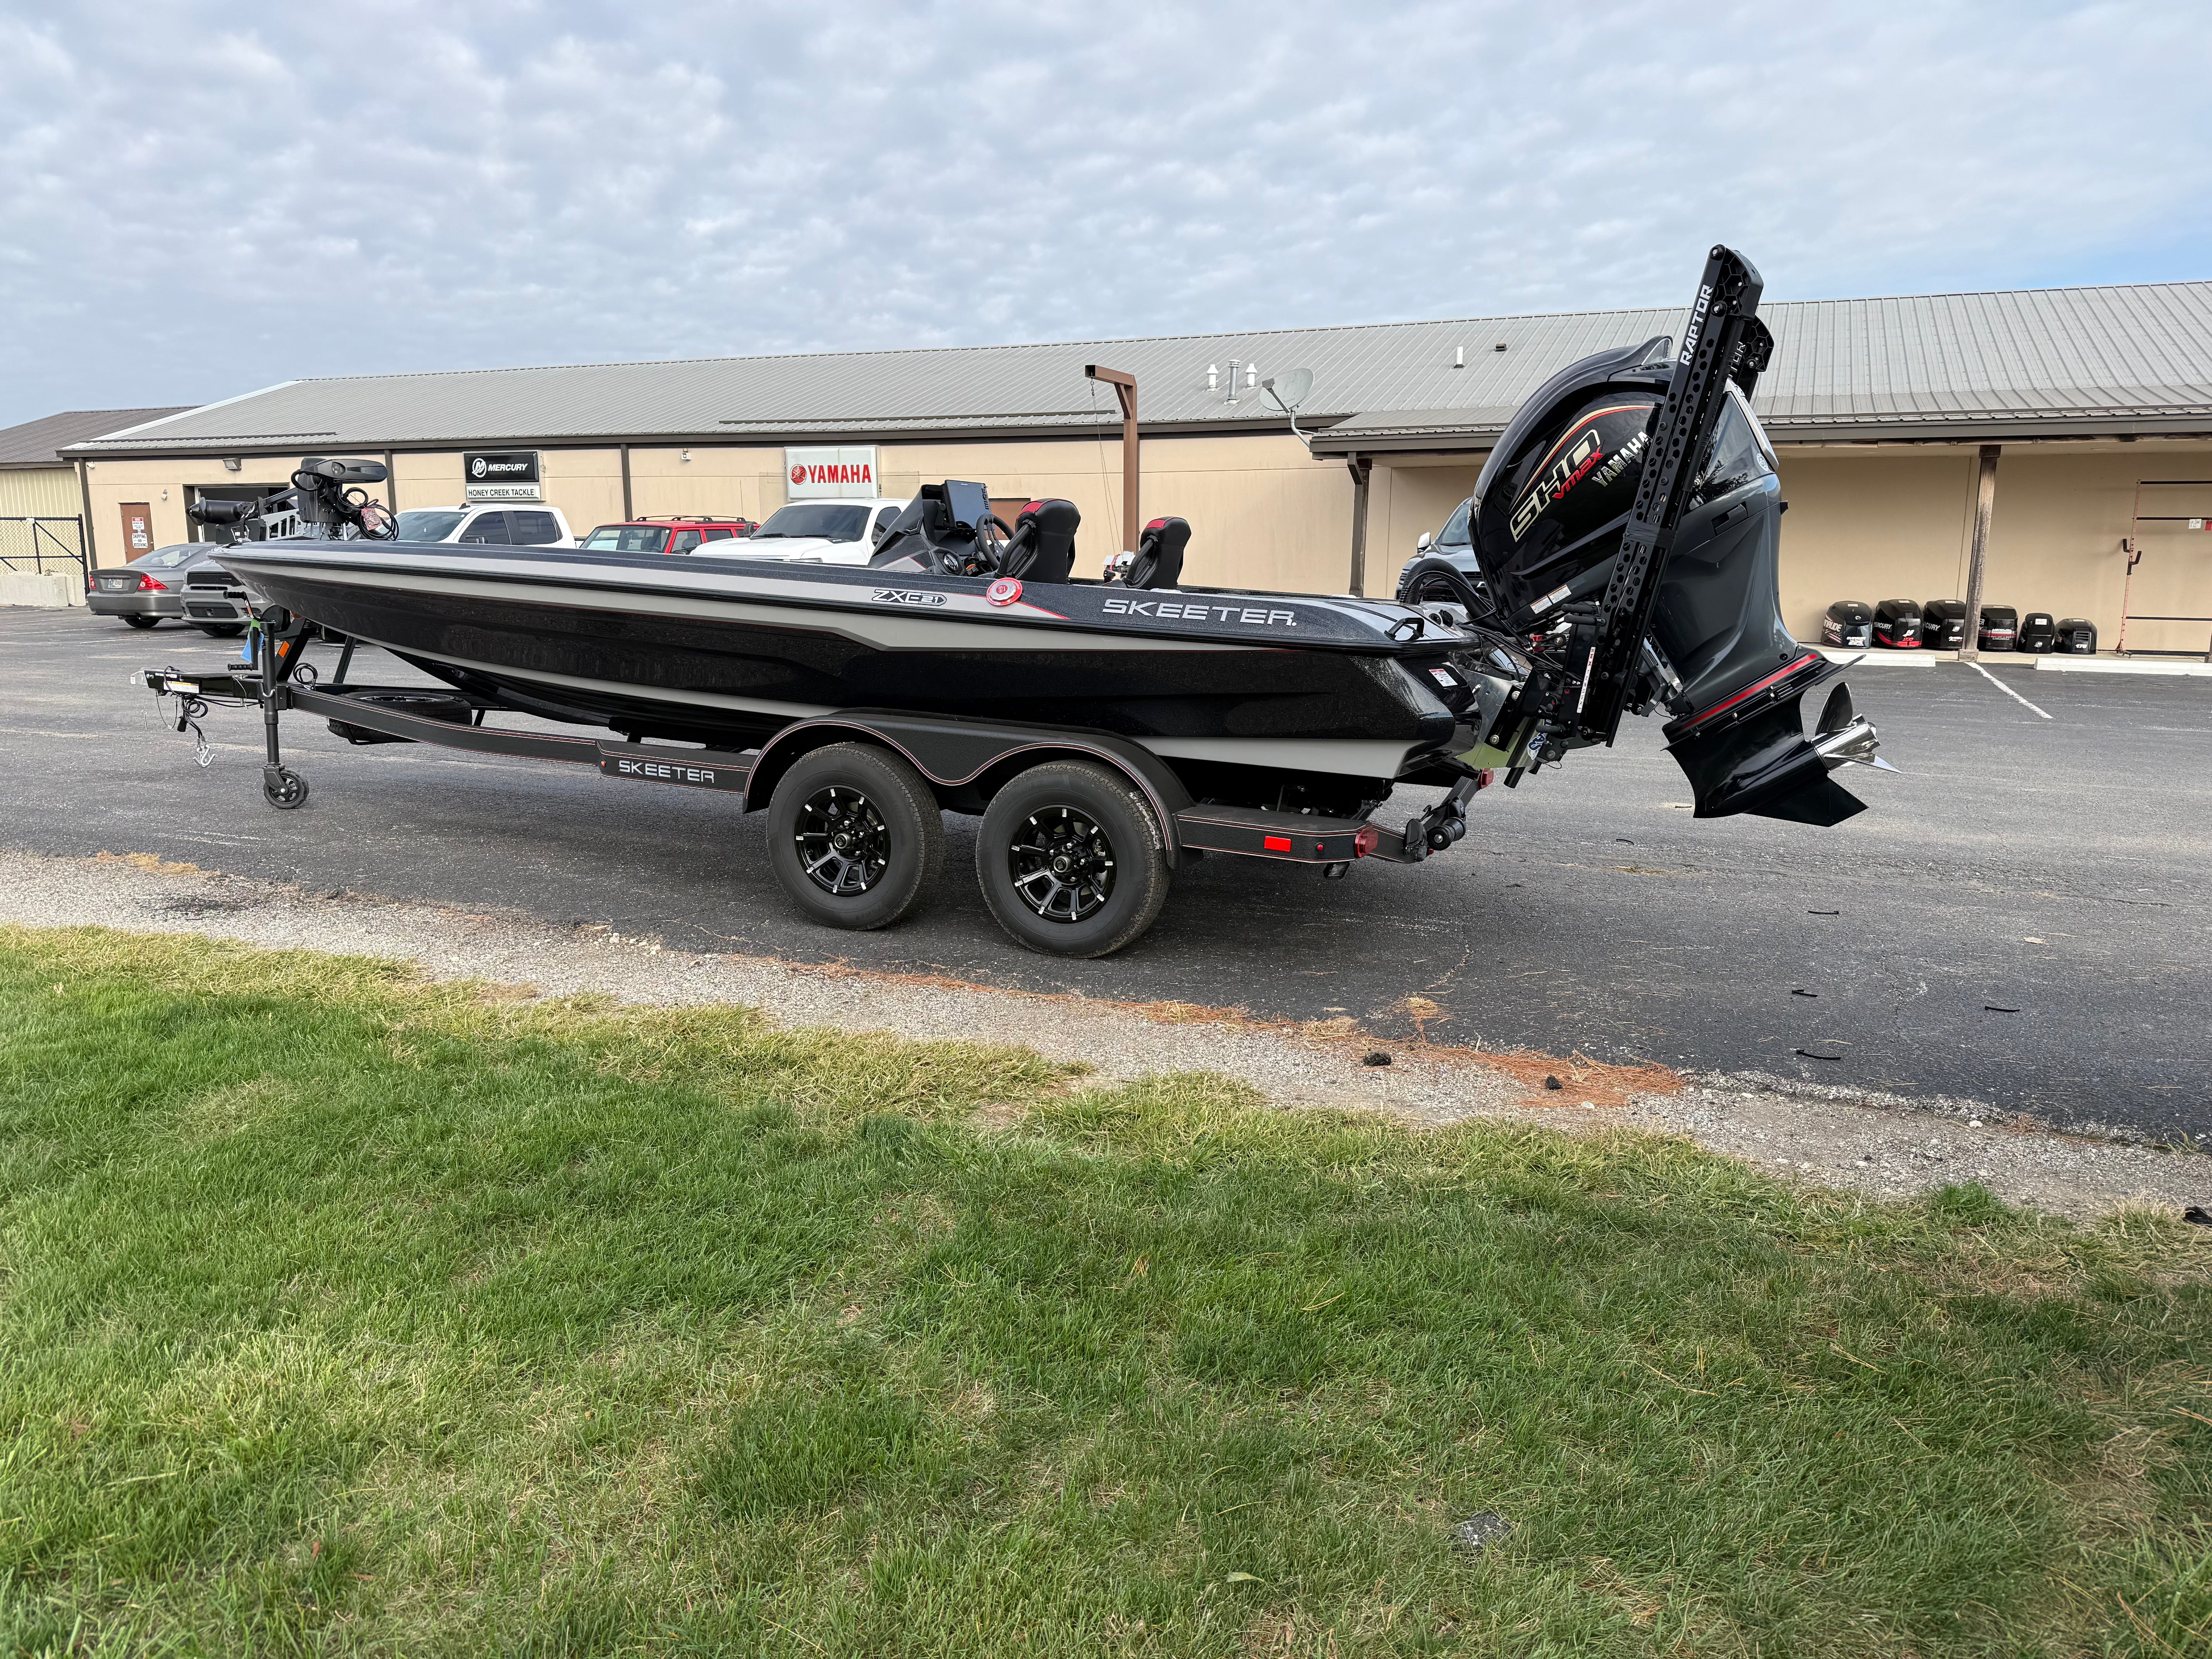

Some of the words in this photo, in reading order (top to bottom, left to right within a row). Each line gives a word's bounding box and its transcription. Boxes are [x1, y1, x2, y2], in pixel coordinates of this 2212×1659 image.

[1680, 284, 1713, 366] RAPTOR
[808, 464, 871, 483] YAMAHA
[1592, 431, 1653, 487] YAMAHA
[1510, 429, 1601, 542] SHO
[1102, 599, 1295, 626] SKEETER
[619, 760, 714, 783] SKEETER
